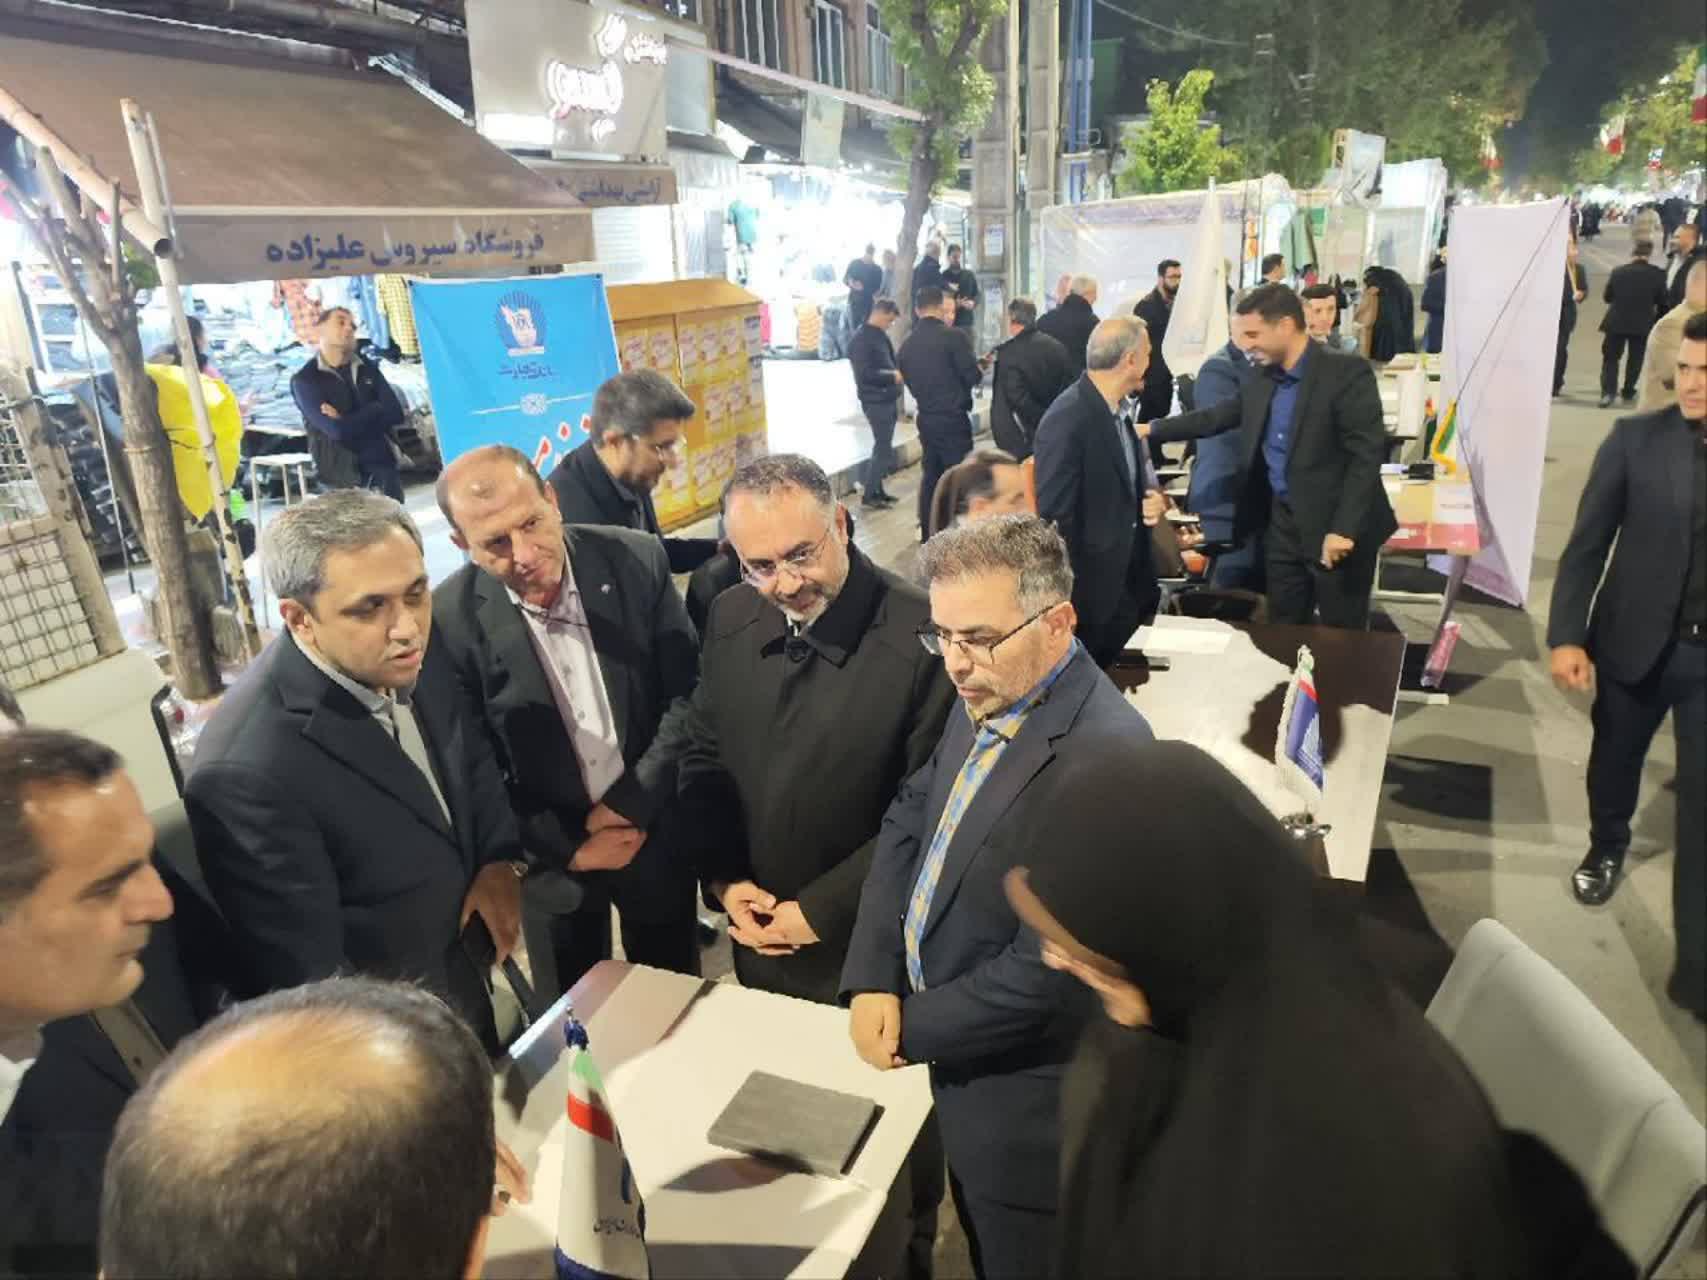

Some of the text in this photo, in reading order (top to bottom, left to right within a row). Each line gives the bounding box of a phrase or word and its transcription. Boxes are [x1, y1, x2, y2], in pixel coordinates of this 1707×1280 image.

[265, 227, 545, 271] فروشگاه سیروس علیزاده
